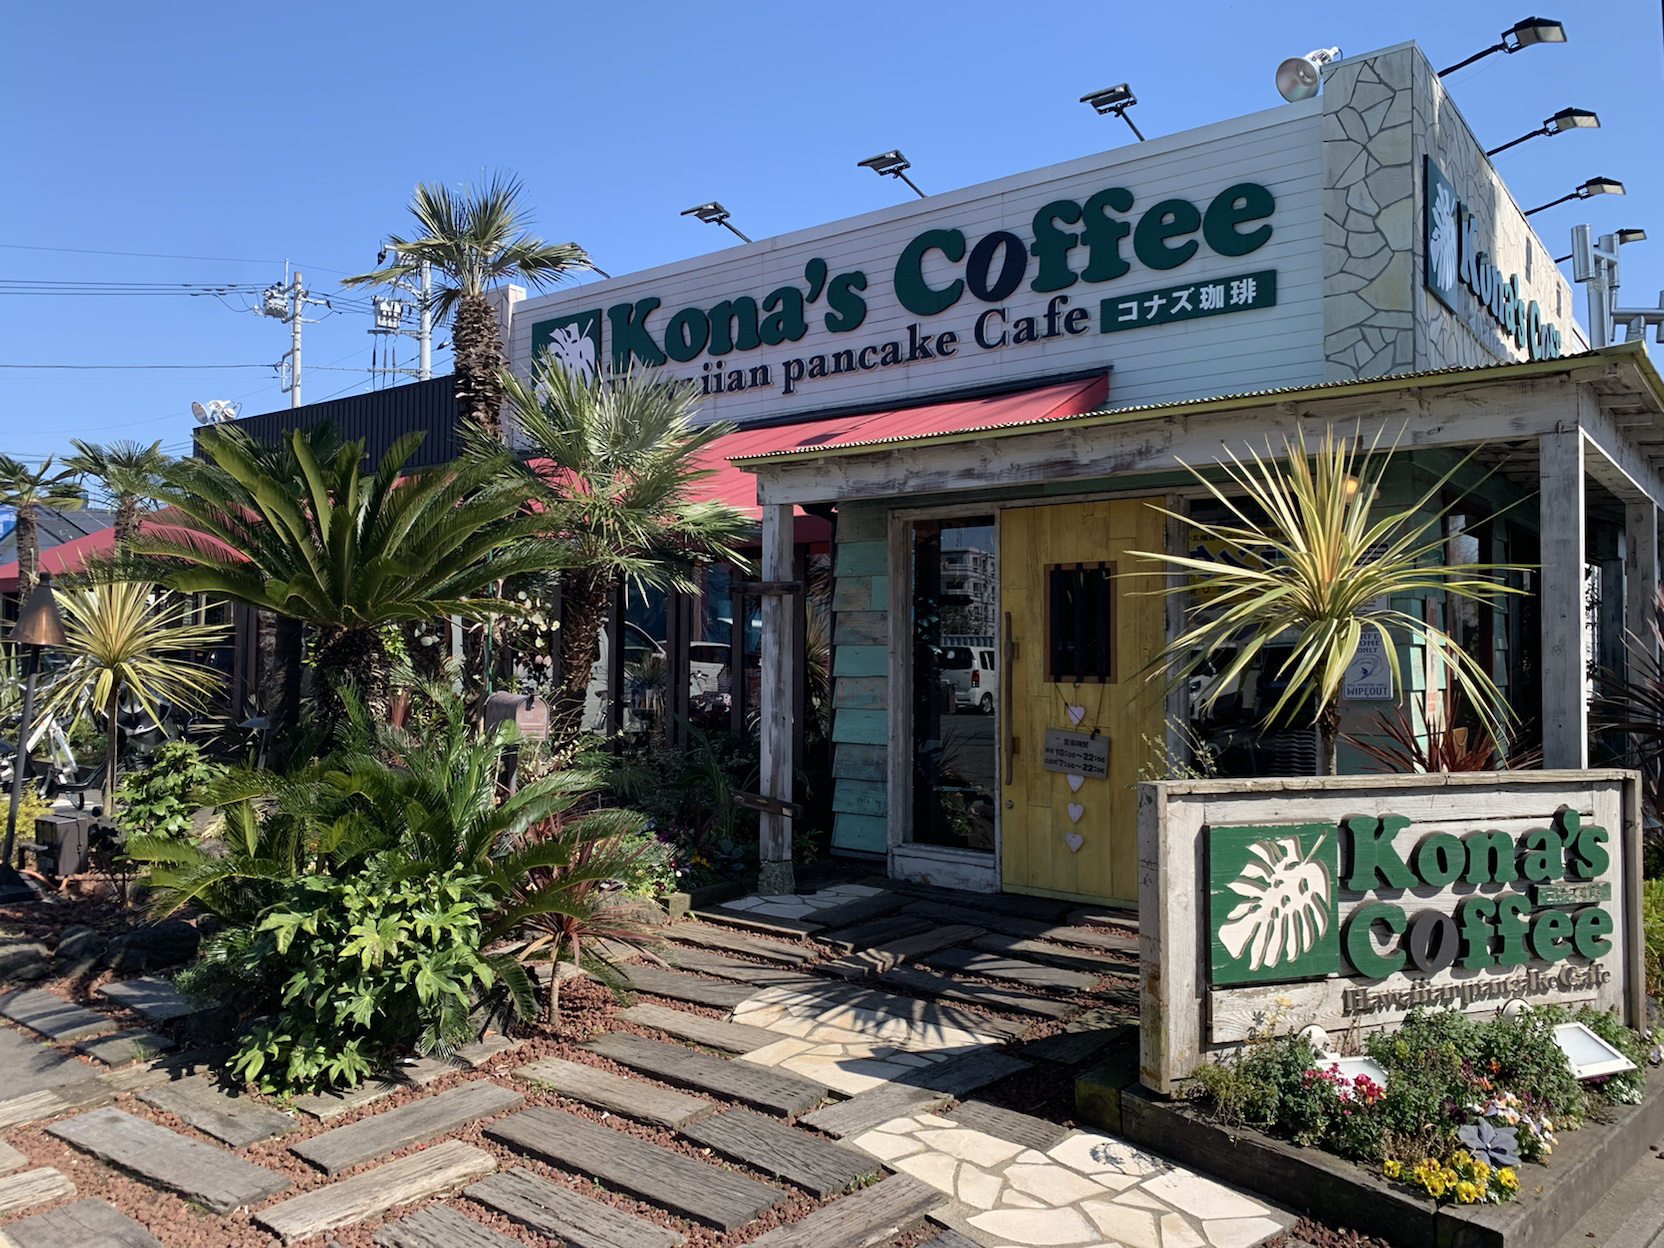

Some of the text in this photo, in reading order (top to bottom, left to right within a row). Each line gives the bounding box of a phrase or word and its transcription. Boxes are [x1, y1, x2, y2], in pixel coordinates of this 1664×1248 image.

[606, 182, 1277, 374] Kona's Coffee
[1117, 277, 1257, 322] コナズ珈琲
[1454, 201, 1526, 349] Kona's
[782, 322, 959, 395] pancake
[974, 295, 1089, 350] Cafe
[1347, 687, 1388, 696] WIPEOUT
[1344, 804, 1610, 892] Kona's
[1344, 892, 1614, 979] Coffee
[1345, 961, 1612, 1013] Hawaiian pancake Cafe
